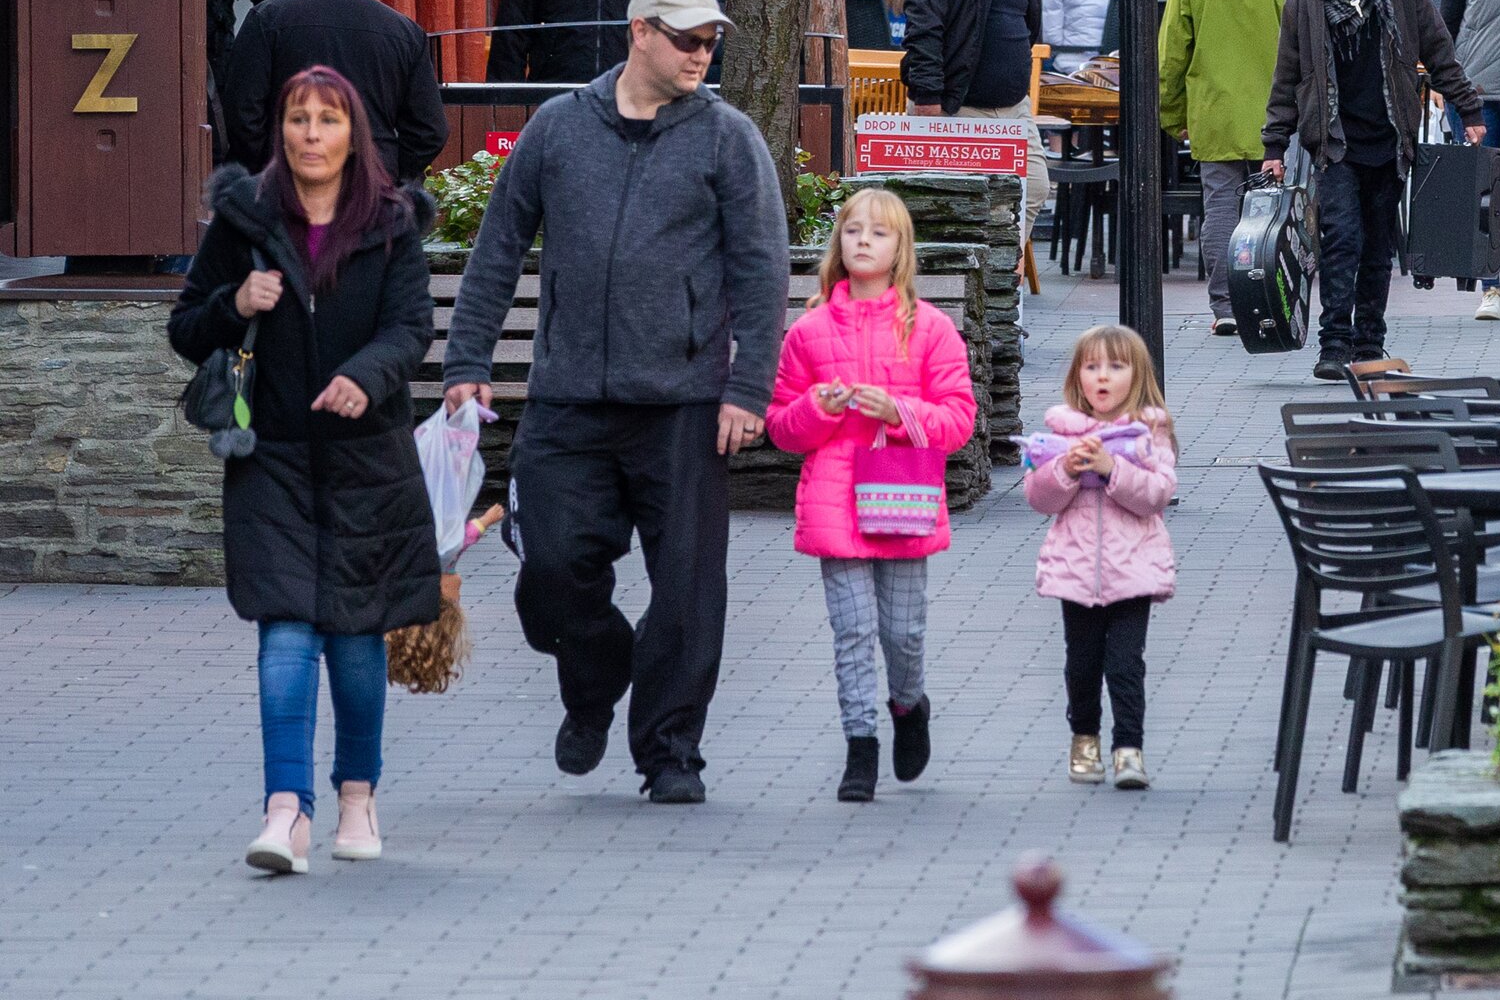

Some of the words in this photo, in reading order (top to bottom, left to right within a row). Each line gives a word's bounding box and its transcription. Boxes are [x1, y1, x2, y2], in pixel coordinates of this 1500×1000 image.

[864, 120, 896, 131] DROP
[900, 121, 911, 132] IN
[929, 122, 970, 134] HEALTH
[974, 124, 1022, 136] MASSAGE
[883, 144, 925, 158] FANS
[928, 146, 1001, 160] MASSAGE
[903, 157, 934, 168] Therapy
[943, 159, 982, 168] Relaxation
